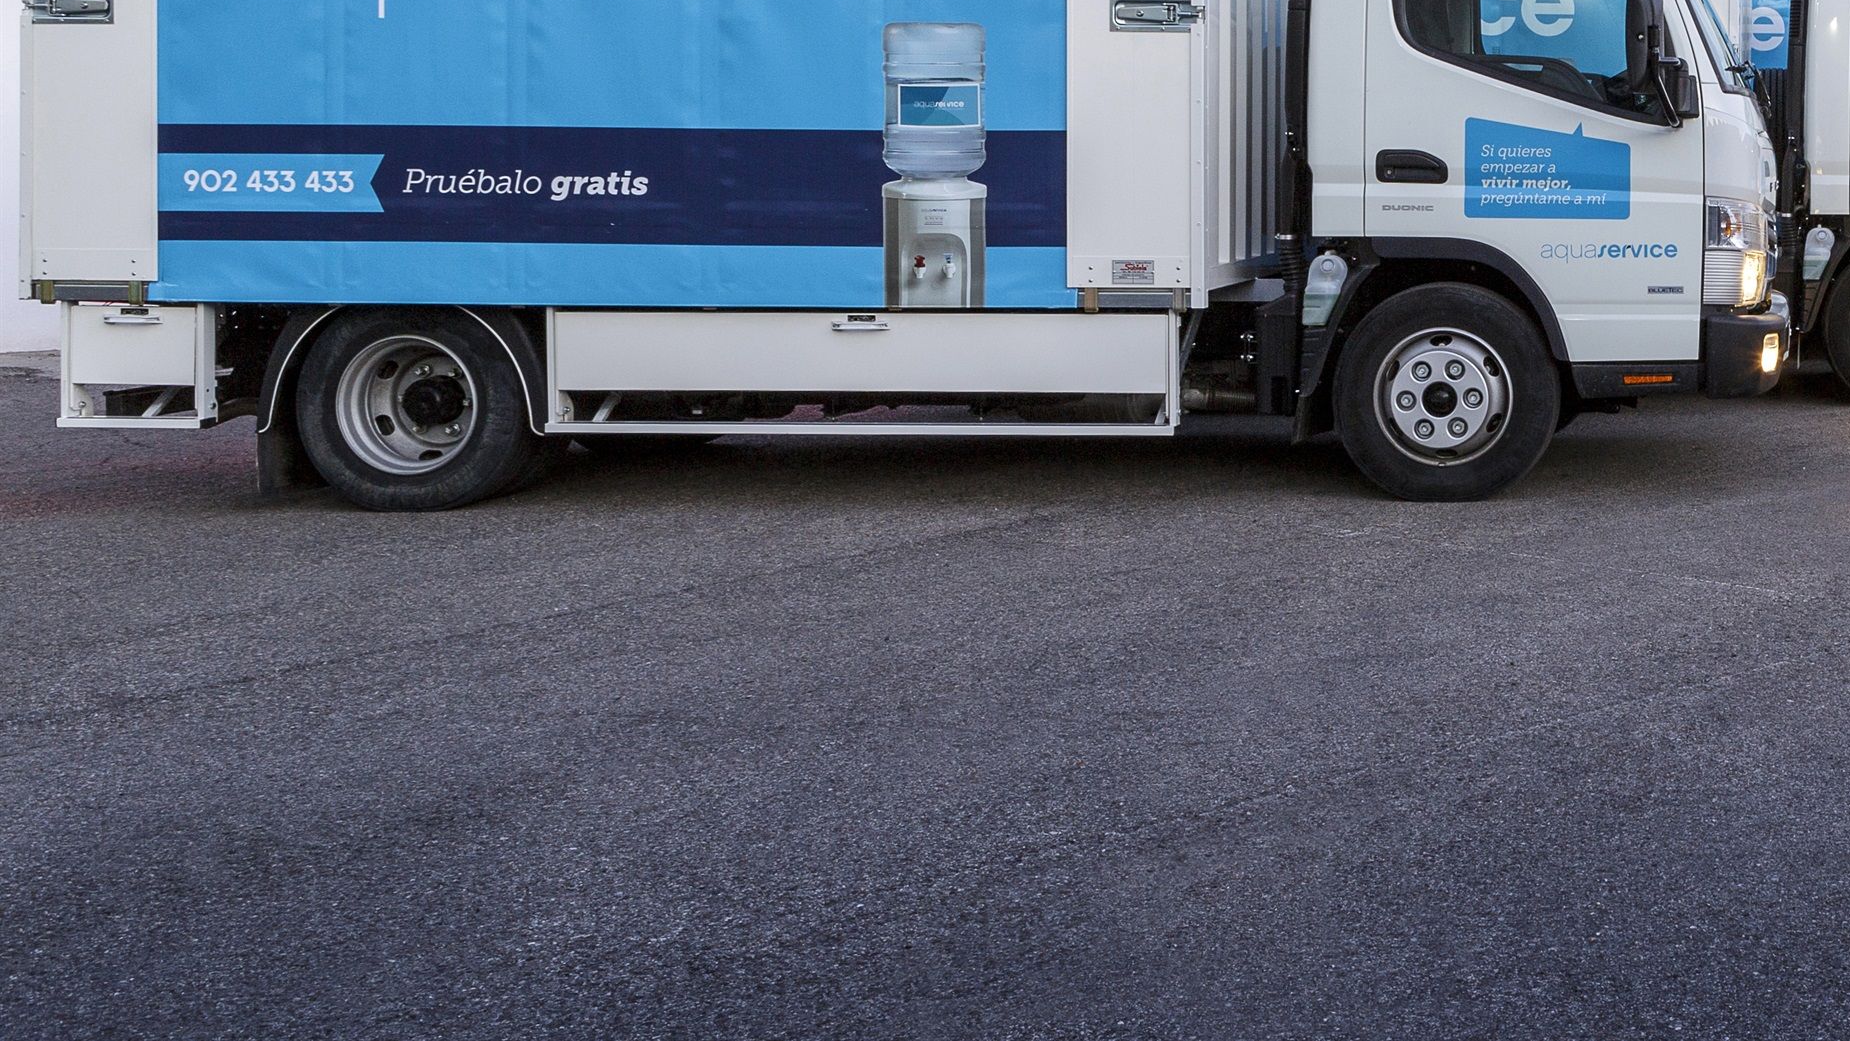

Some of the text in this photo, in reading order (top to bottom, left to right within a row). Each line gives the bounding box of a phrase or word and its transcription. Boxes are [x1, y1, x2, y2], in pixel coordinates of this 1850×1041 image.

[1481, 144, 1552, 160] Si quieres
[1480, 162, 1556, 175] empezar a
[183, 169, 354, 193] 902 433 433
[403, 167, 649, 202] Pruébalo gratis
[1481, 177, 1572, 192] vivir mejor,
[1480, 192, 1607, 207] pregúntame a mí
[1540, 242, 1678, 264] aquaservice
